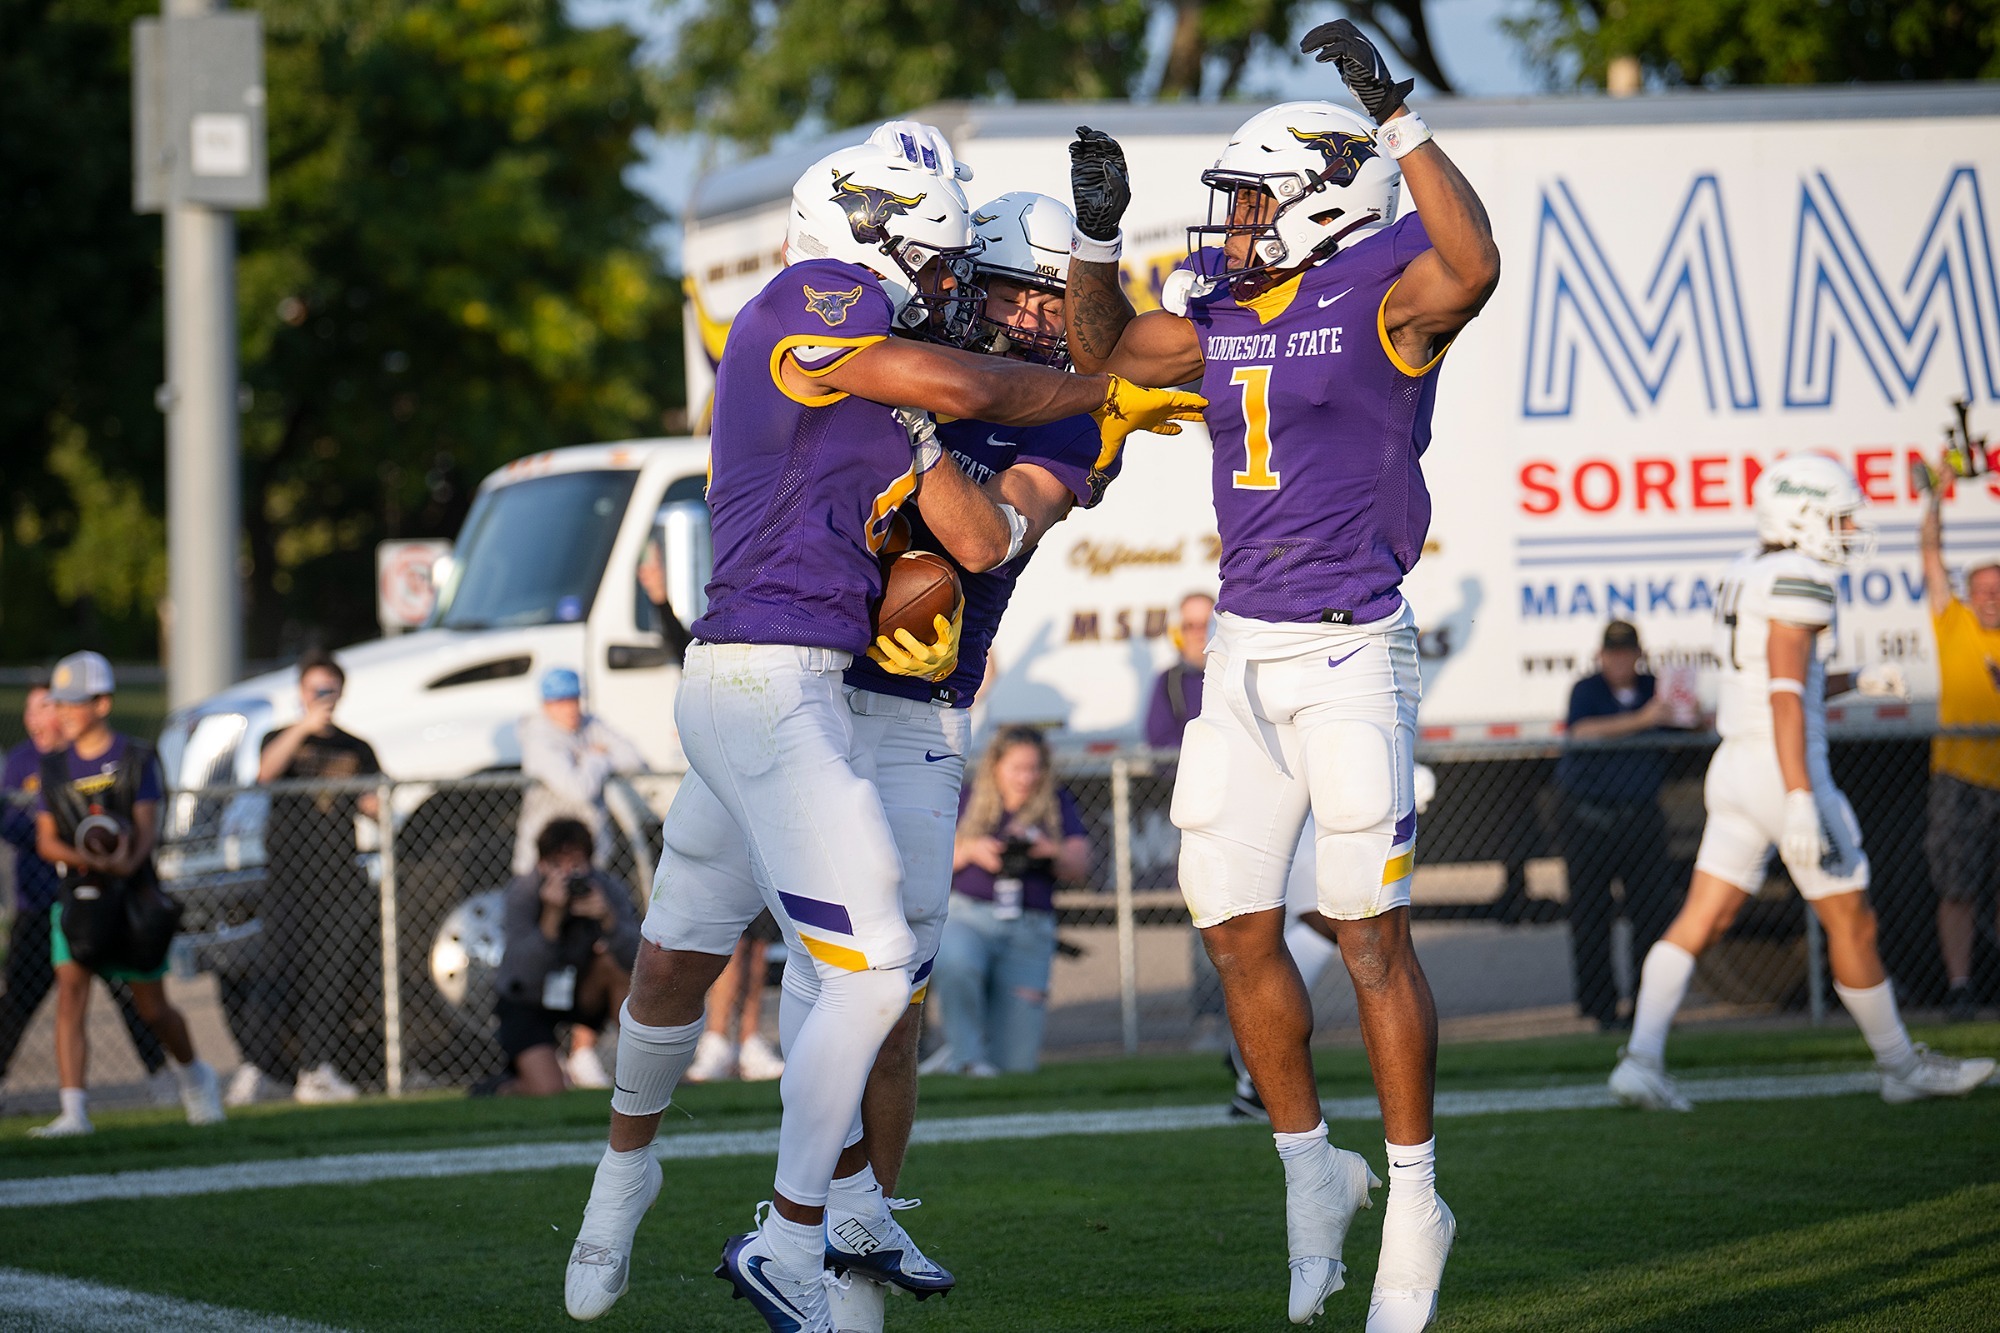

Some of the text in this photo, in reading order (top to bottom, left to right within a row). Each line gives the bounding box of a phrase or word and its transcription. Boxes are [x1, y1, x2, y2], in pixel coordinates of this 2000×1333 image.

[1034, 262, 1061, 278] MSU
[1206, 326, 1343, 361] MINNESOTA STATE
[1229, 364, 1281, 490] 1
[1521, 578, 1714, 617] MANKA
[1331, 612, 1345, 622] M
[939, 689, 950, 700] M
[833, 1217, 881, 1258] NIKE
